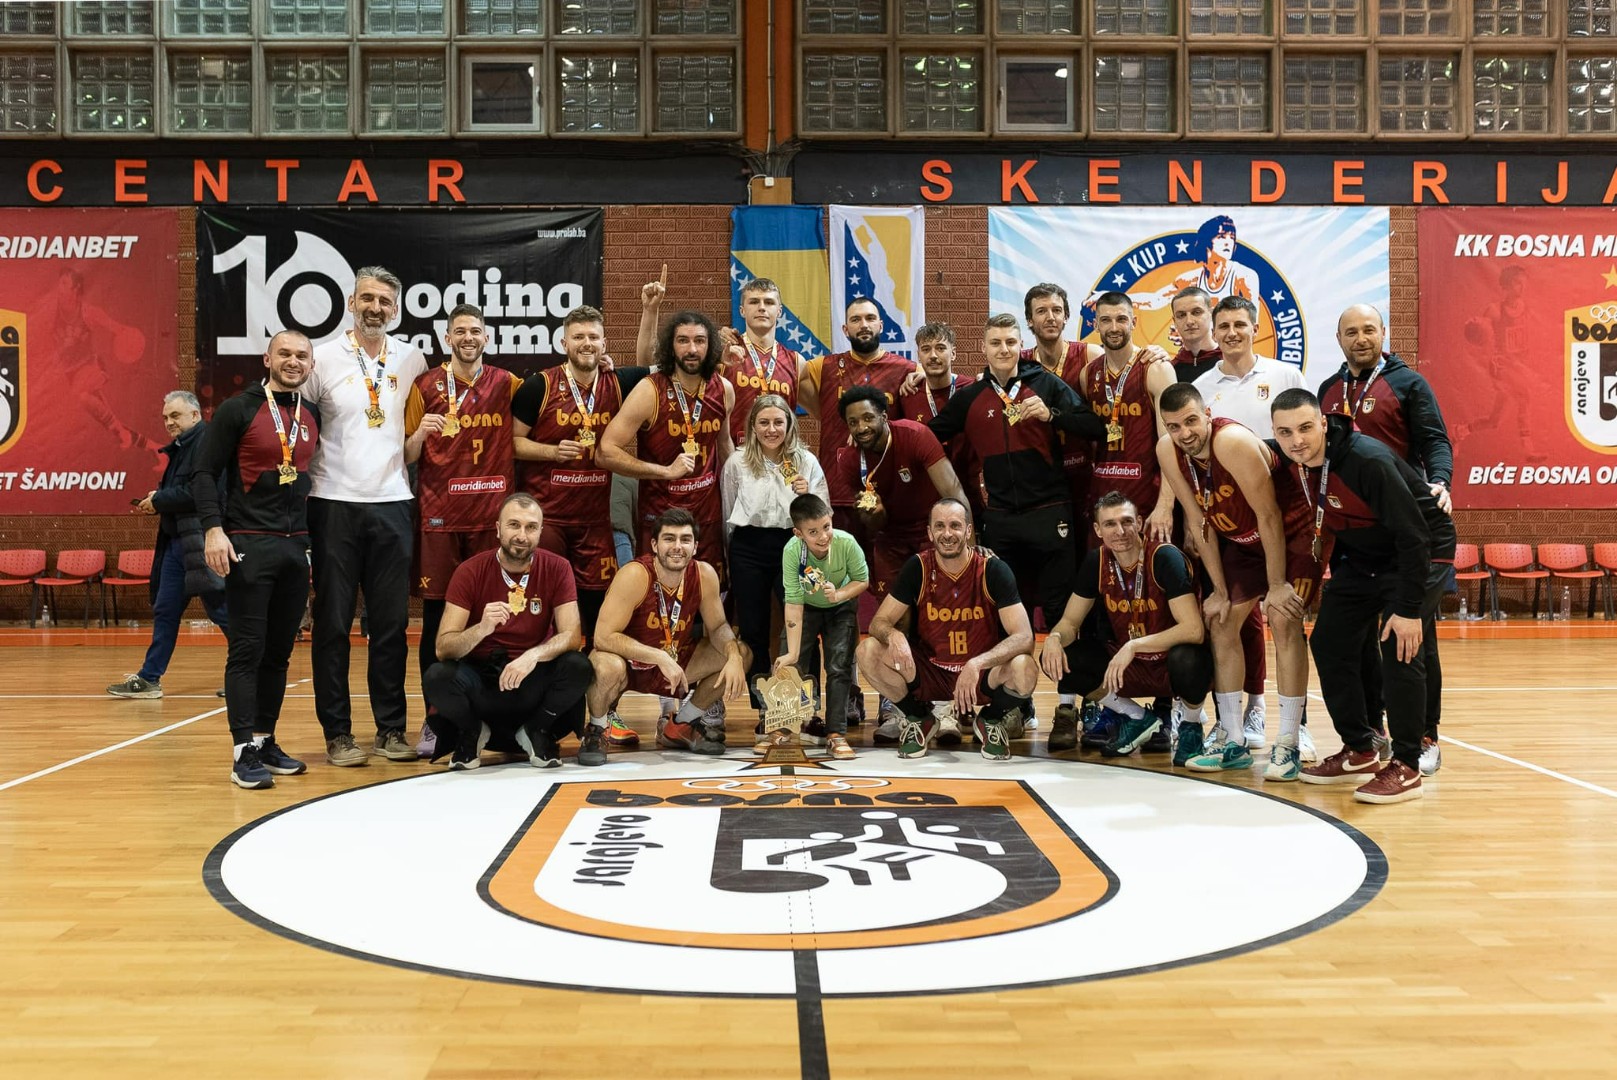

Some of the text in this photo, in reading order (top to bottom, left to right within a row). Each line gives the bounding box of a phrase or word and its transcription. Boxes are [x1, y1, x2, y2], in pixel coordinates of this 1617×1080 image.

[27, 159, 466, 203] CENTAR
[537, 227, 587, 239] www.prolab.ba
[1454, 234, 1493, 257] KK
[1495, 234, 1585, 257] BOSNA
[1127, 242, 1167, 277] KUP
[735, 371, 790, 396] bona
[1573, 350, 1591, 416] sarajevo
[556, 408, 611, 426] bona
[1092, 400, 1142, 417] bona
[460, 412, 503, 429] osna
[472, 439, 484, 465] 7
[20, 467, 127, 491] ŠAMPION!
[552, 472, 606, 484] meridianbet
[1468, 462, 1518, 485] BIĆE
[1519, 466, 1591, 485] BOSNA
[450, 480, 504, 492] meridianbet
[926, 602, 985, 622] bosna
[948, 631, 968, 655] 18
[585, 789, 959, 808] bosna
[569, 814, 664, 887] sarajevo
